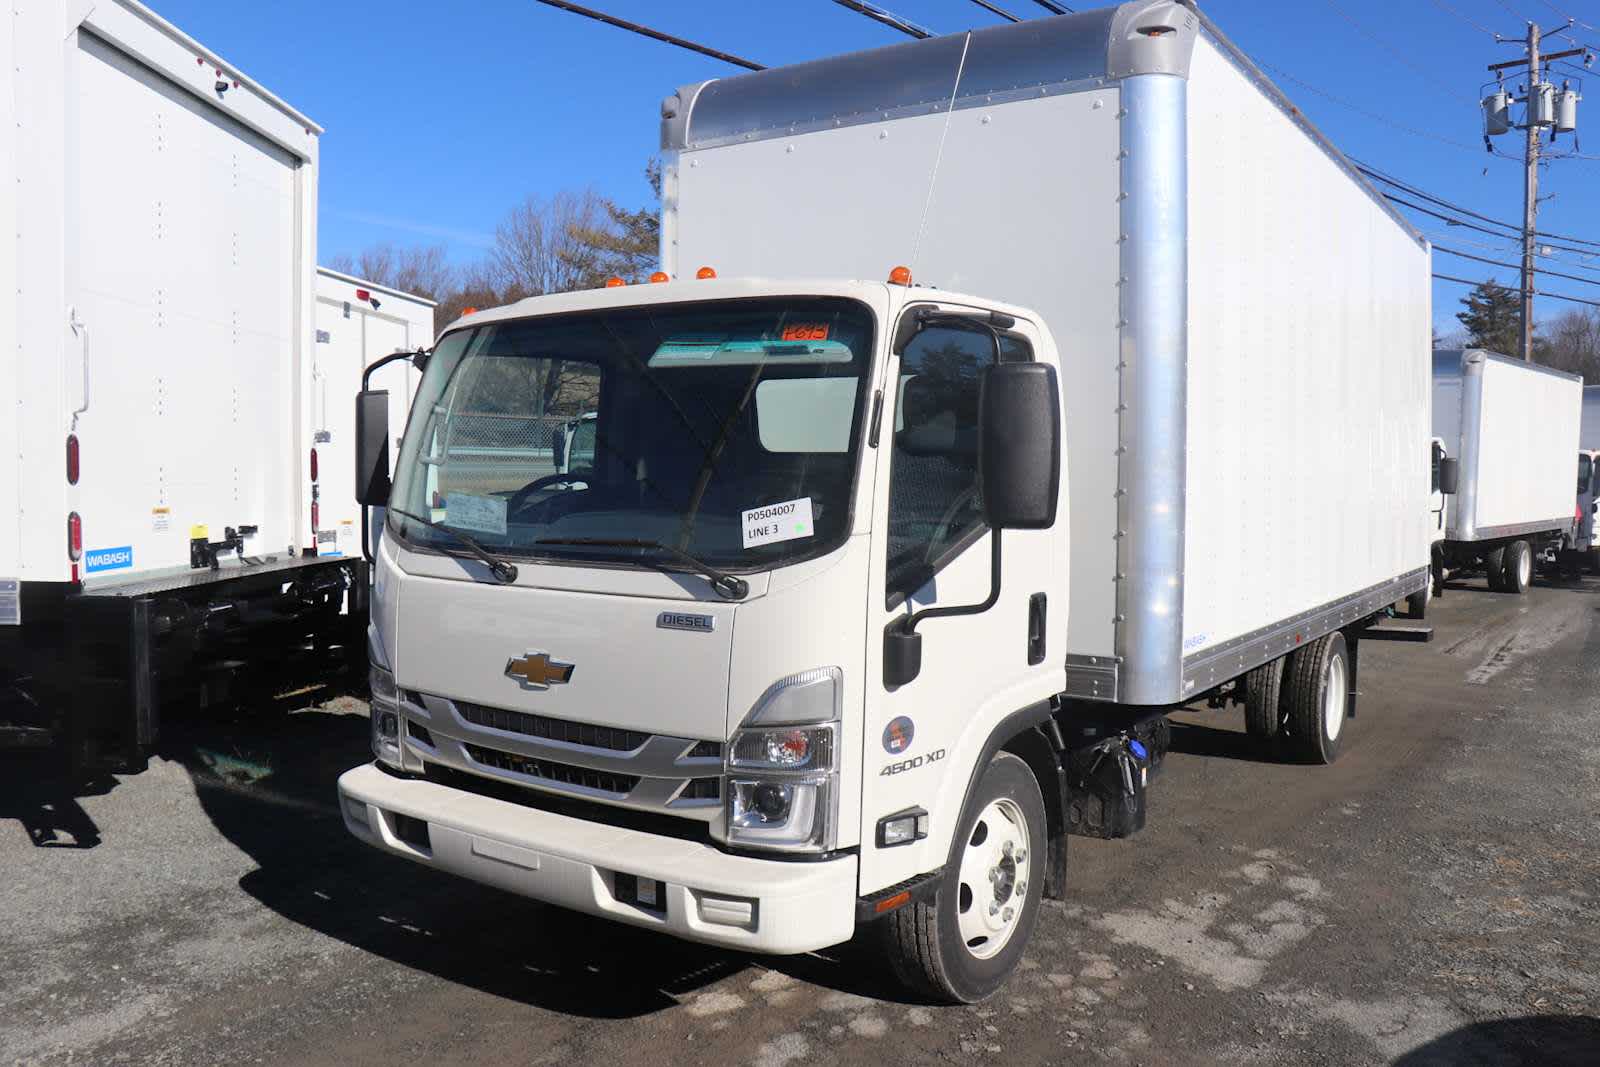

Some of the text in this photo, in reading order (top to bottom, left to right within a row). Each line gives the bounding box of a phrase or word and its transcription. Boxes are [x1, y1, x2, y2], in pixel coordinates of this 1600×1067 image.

[747, 504, 796, 522] P0504007
[748, 524, 779, 539] LINE 3
[87, 551, 130, 568] WABASH
[663, 614, 710, 627] DIESEL
[879, 749, 946, 776] 4500 XD
